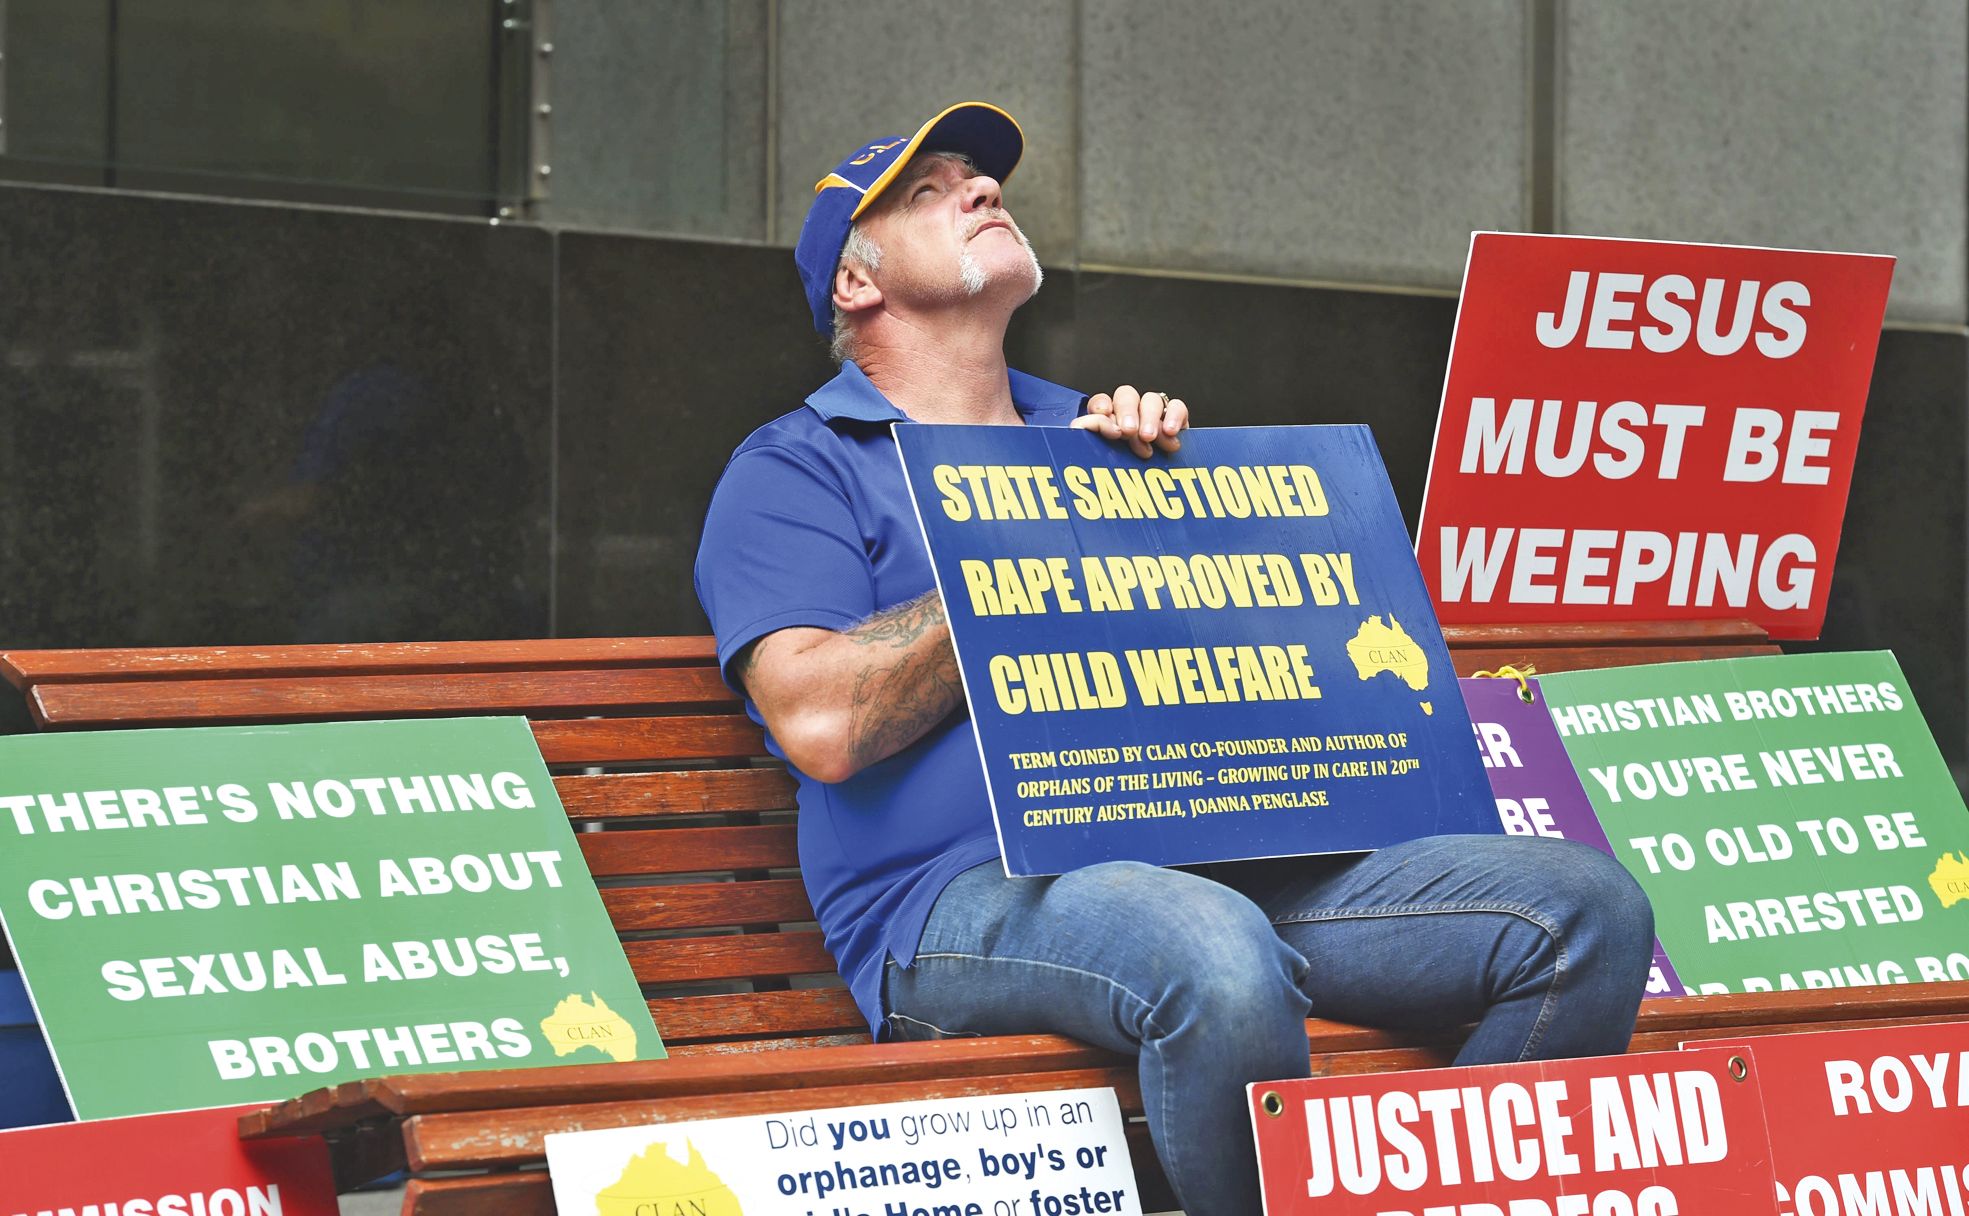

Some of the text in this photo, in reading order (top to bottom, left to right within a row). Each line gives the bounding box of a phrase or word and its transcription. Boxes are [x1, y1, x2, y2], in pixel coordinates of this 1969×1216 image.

[1535, 271, 1811, 359] JESUS
[1459, 397, 1840, 485] MUST BE
[932, 464, 1330, 522] STATE SANCTIONED
[960, 552, 1361, 617] RAPE APPROVED BY
[1440, 526, 1817, 610] WEEPING
[989, 644, 1322, 715] CHILD WELFARE
[1368, 649, 1408, 664] CLAN
[1550, 681, 1904, 737] HRISTIAN BROTHERS
[1009, 732, 1408, 770] TERM COINED BY CLAN CO-FOUNDER AND AUTHOR OF
[1017, 777, 1091, 798] ORPHANS
[1093, 775, 1115, 793] OF
[1117, 773, 1149, 791] THE
[1152, 770, 1204, 788] LIVING
[1217, 765, 1289, 785] GROWING
[1290, 764, 1311, 780] UP
[1313, 763, 1330, 779] IN
[1332, 761, 1369, 778] CARE
[1371, 760, 1388, 776] IN
[1390, 758, 1420, 775] 20TH
[1758, 743, 1904, 787] NEVER
[0, 771, 537, 835] THERE'S NOTHING
[1023, 790, 1330, 827] CENTURY AUSTRALIA, JOANNA PENGLASE
[1628, 811, 1928, 874] TO OLD TO BE
[27, 850, 563, 920] CHRISTIAN ABOUT
[1704, 885, 1924, 944] ARRESTED
[101, 932, 571, 1002] SEXUAL ABUSE,
[207, 1017, 533, 1081] BROTHERS
[566, 1025, 614, 1040] CLAN
[765, 1099, 1093, 1151] Did you grow up in an
[1304, 1070, 1728, 1198] JUSTICE AND
[777, 1143, 1108, 1200] orphanage, boy's or
[1775, 1163, 1969, 1216] OMMI
[993, 1198, 1021, 1216] or
[1029, 1186, 1125, 1216] foster
